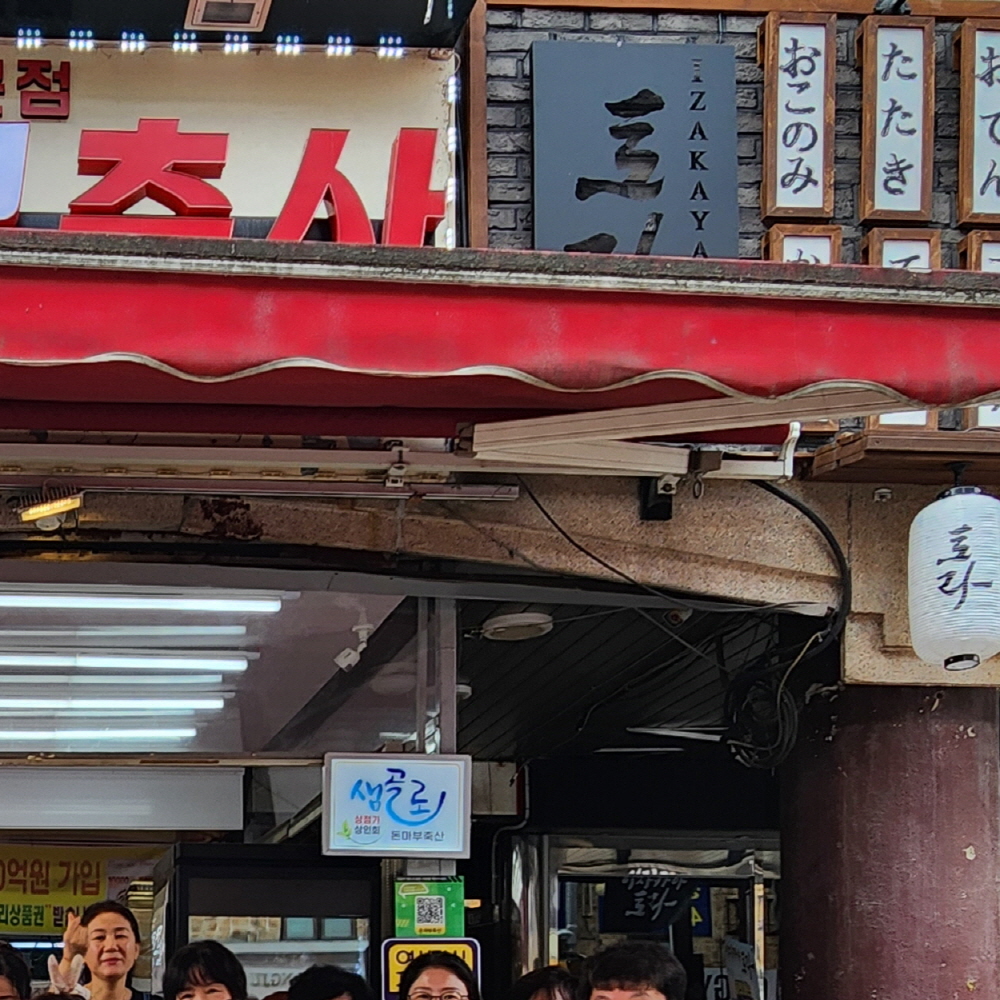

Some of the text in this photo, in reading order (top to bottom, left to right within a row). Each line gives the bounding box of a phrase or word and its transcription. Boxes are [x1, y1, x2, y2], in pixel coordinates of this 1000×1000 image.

[687, 58, 710, 258] IZAKAYA
[780, 37, 821, 194] おこのみ
[881, 42, 917, 195] たたき
[58, 858, 100, 896] 가입
[354, 826, 380, 835] 상인회
[391, 830, 444, 842] 돈마부축산
